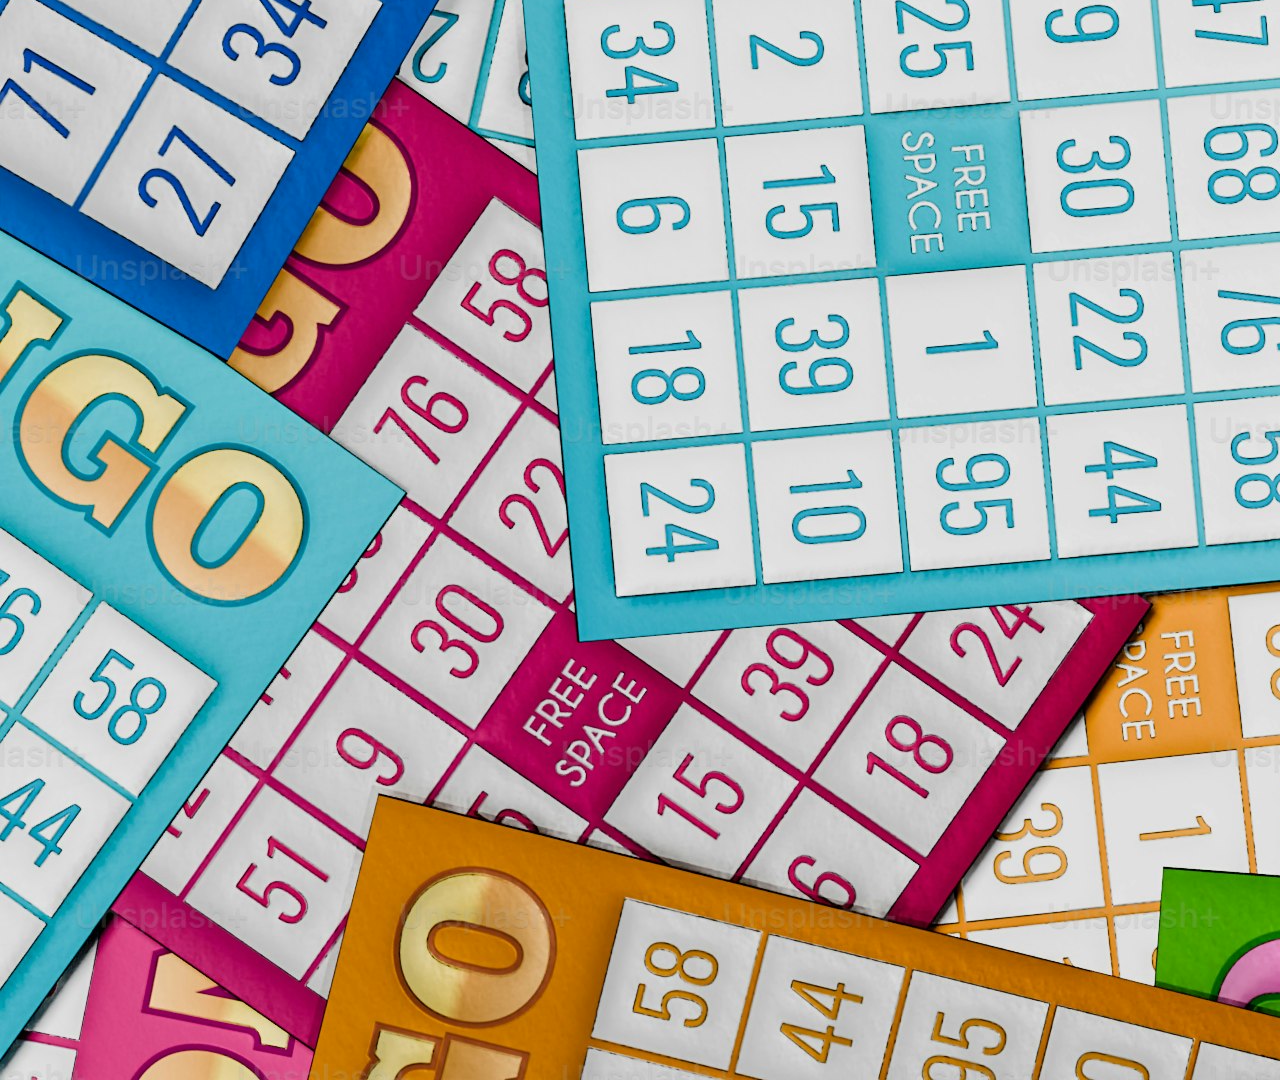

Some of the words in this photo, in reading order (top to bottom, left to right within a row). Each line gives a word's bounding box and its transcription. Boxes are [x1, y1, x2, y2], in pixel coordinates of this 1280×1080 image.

[601, 21, 679, 104] 34
[138, 125, 235, 236] 27
[763, 165, 840, 239] 15
[902, 132, 944, 253] SPACE
[951, 144, 991, 232] FREE
[1056, 136, 1134, 217] 30
[461, 248, 549, 343] 58
[629, 330, 705, 405] 18
[926, 330, 998, 354] 1
[373, 376, 469, 464] 76
[790, 470, 866, 544] 10
[1085, 442, 1161, 523] 44
[411, 585, 504, 678] 30
[1161, 630, 1201, 718] FREE
[73, 649, 166, 745] 58
[523, 659, 597, 745] FREE
[741, 628, 834, 722] 39
[1118, 640, 1155, 740] PACE
[549, 673, 647, 786] SPACE
[867, 716, 953, 798] 18
[658, 754, 744, 839] 15
[236, 836, 329, 924] 51
[993, 802, 1068, 885] 39
[633, 942, 718, 1027] 58
[780, 980, 864, 1063] 44
